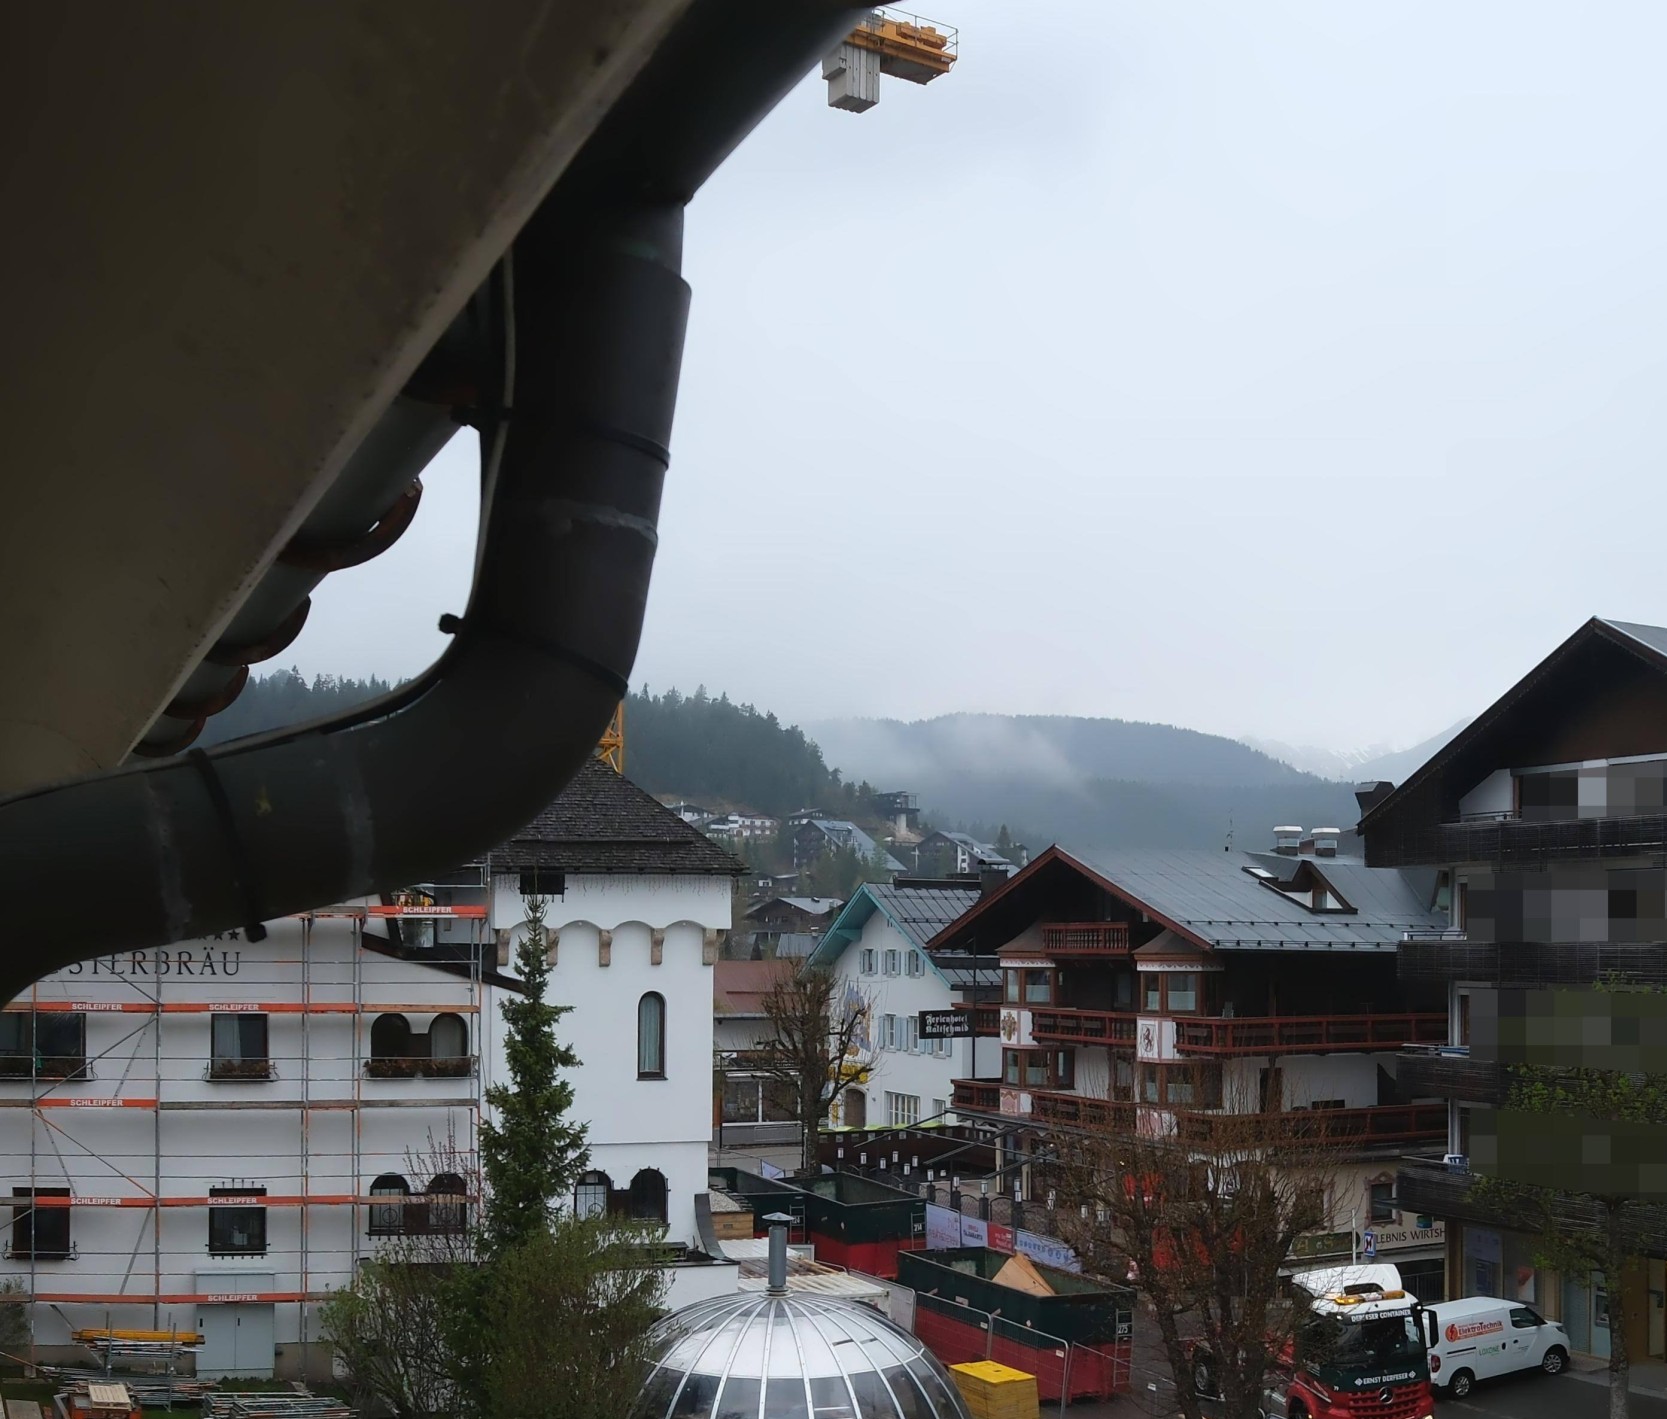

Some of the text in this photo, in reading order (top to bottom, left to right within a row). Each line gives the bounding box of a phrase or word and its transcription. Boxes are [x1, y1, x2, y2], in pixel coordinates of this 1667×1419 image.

[402, 906, 452, 914] SCHLEIPFER
[49, 947, 241, 976] STERBRÄU
[71, 1003, 122, 1011] SCHLEIPFER
[70, 1099, 123, 1107] SCHLEIPFER
[70, 1197, 121, 1206] SCHLEIPFER
[1376, 1231, 1407, 1244] LEBNIS
[1380, 1309, 1411, 1318] CONTAINER
